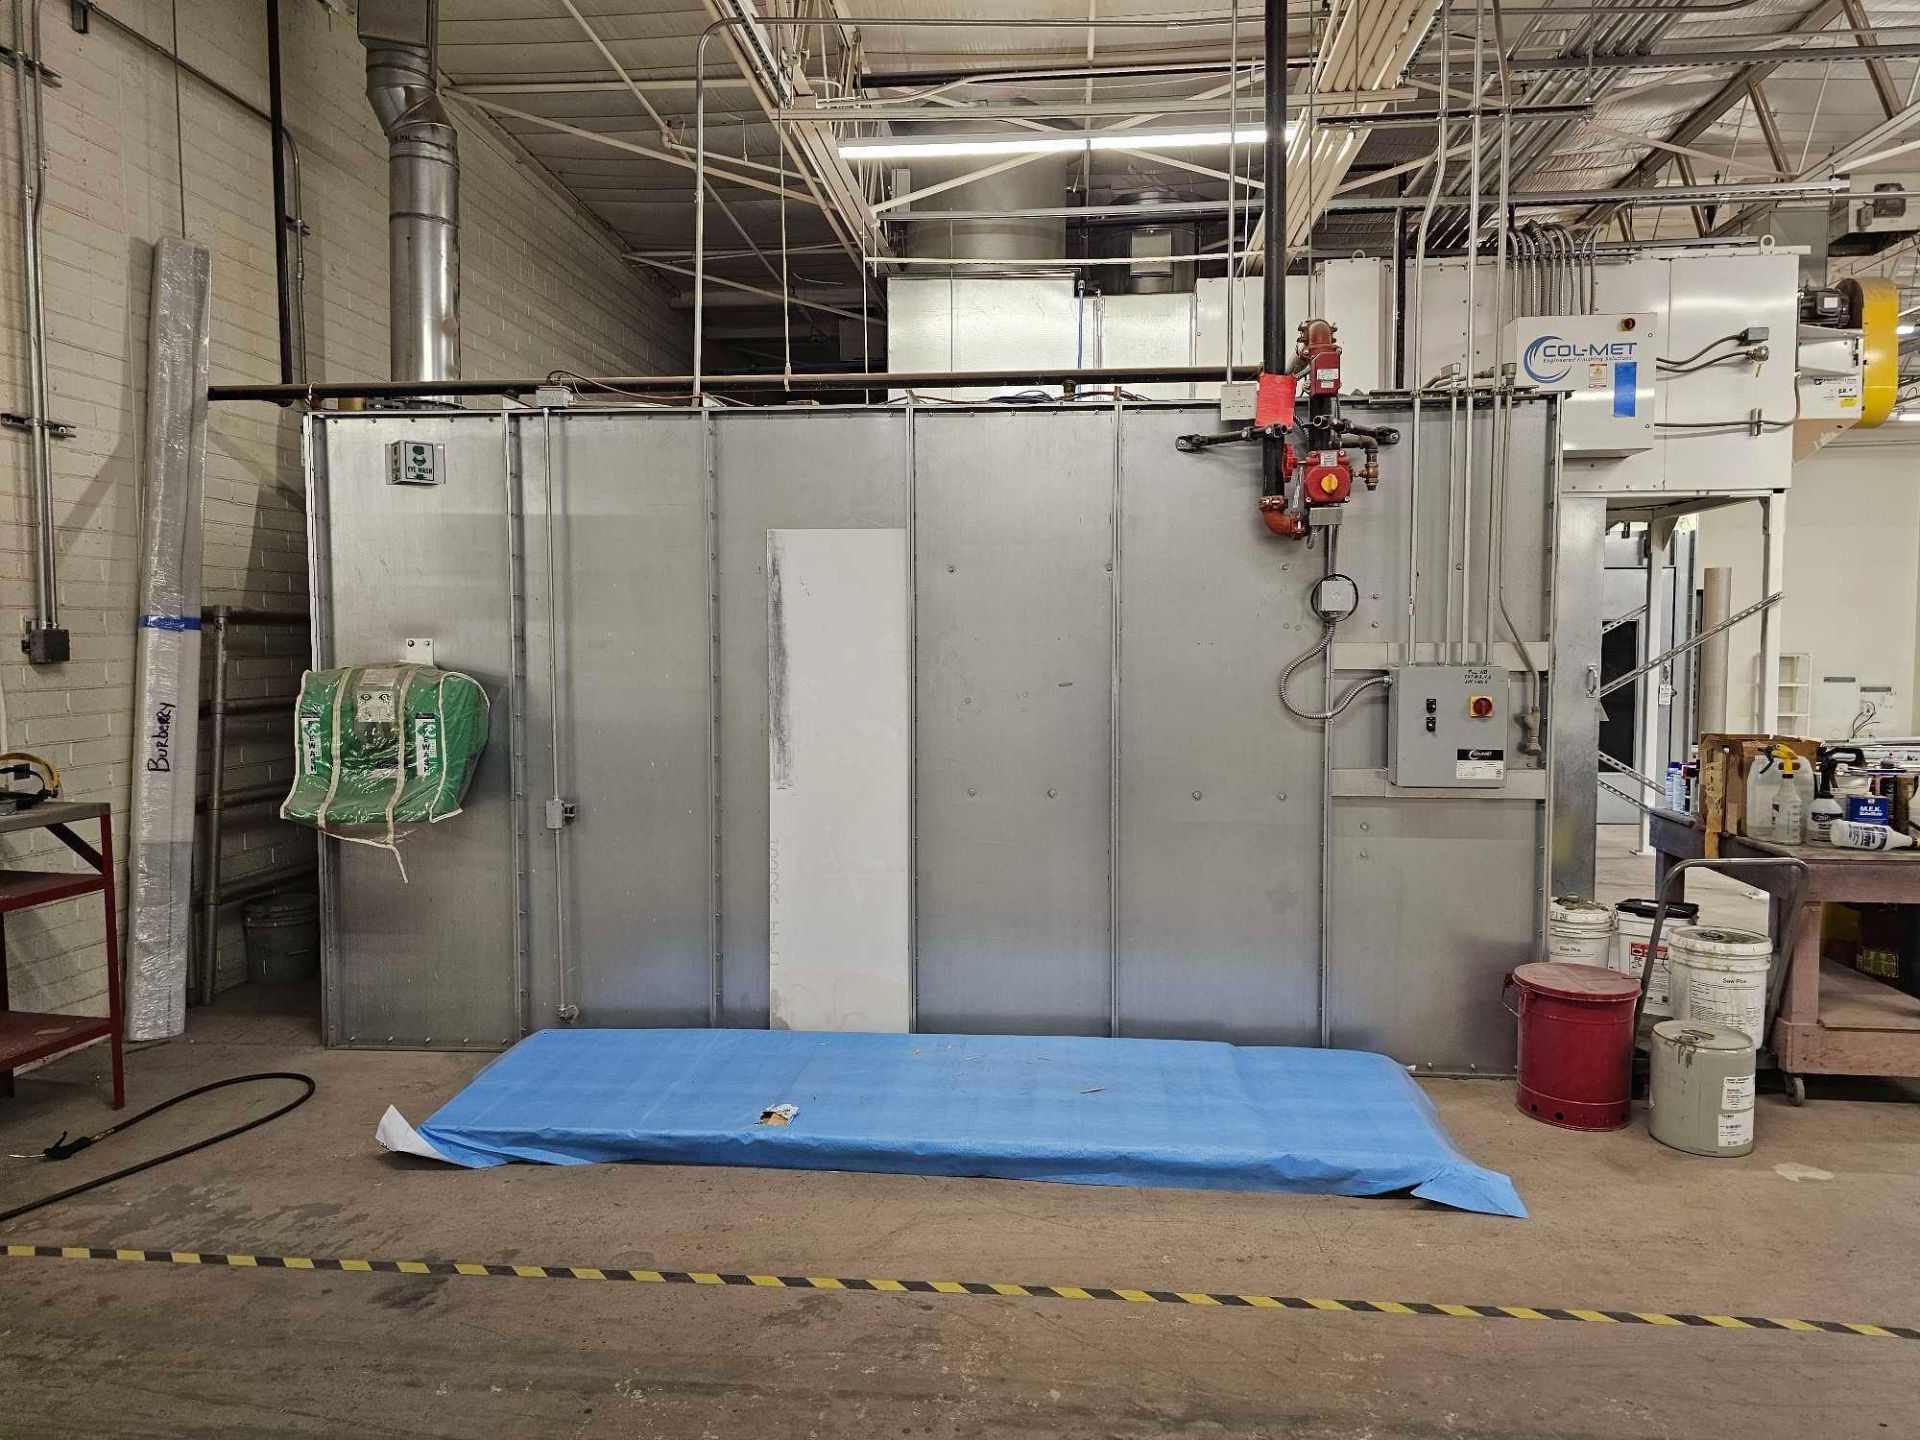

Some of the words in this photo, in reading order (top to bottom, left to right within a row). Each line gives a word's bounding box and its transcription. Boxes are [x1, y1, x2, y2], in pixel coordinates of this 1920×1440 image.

[1543, 342, 1638, 358] COL-MET
[407, 465, 416, 473] EYE
[417, 466, 433, 475] WASH
